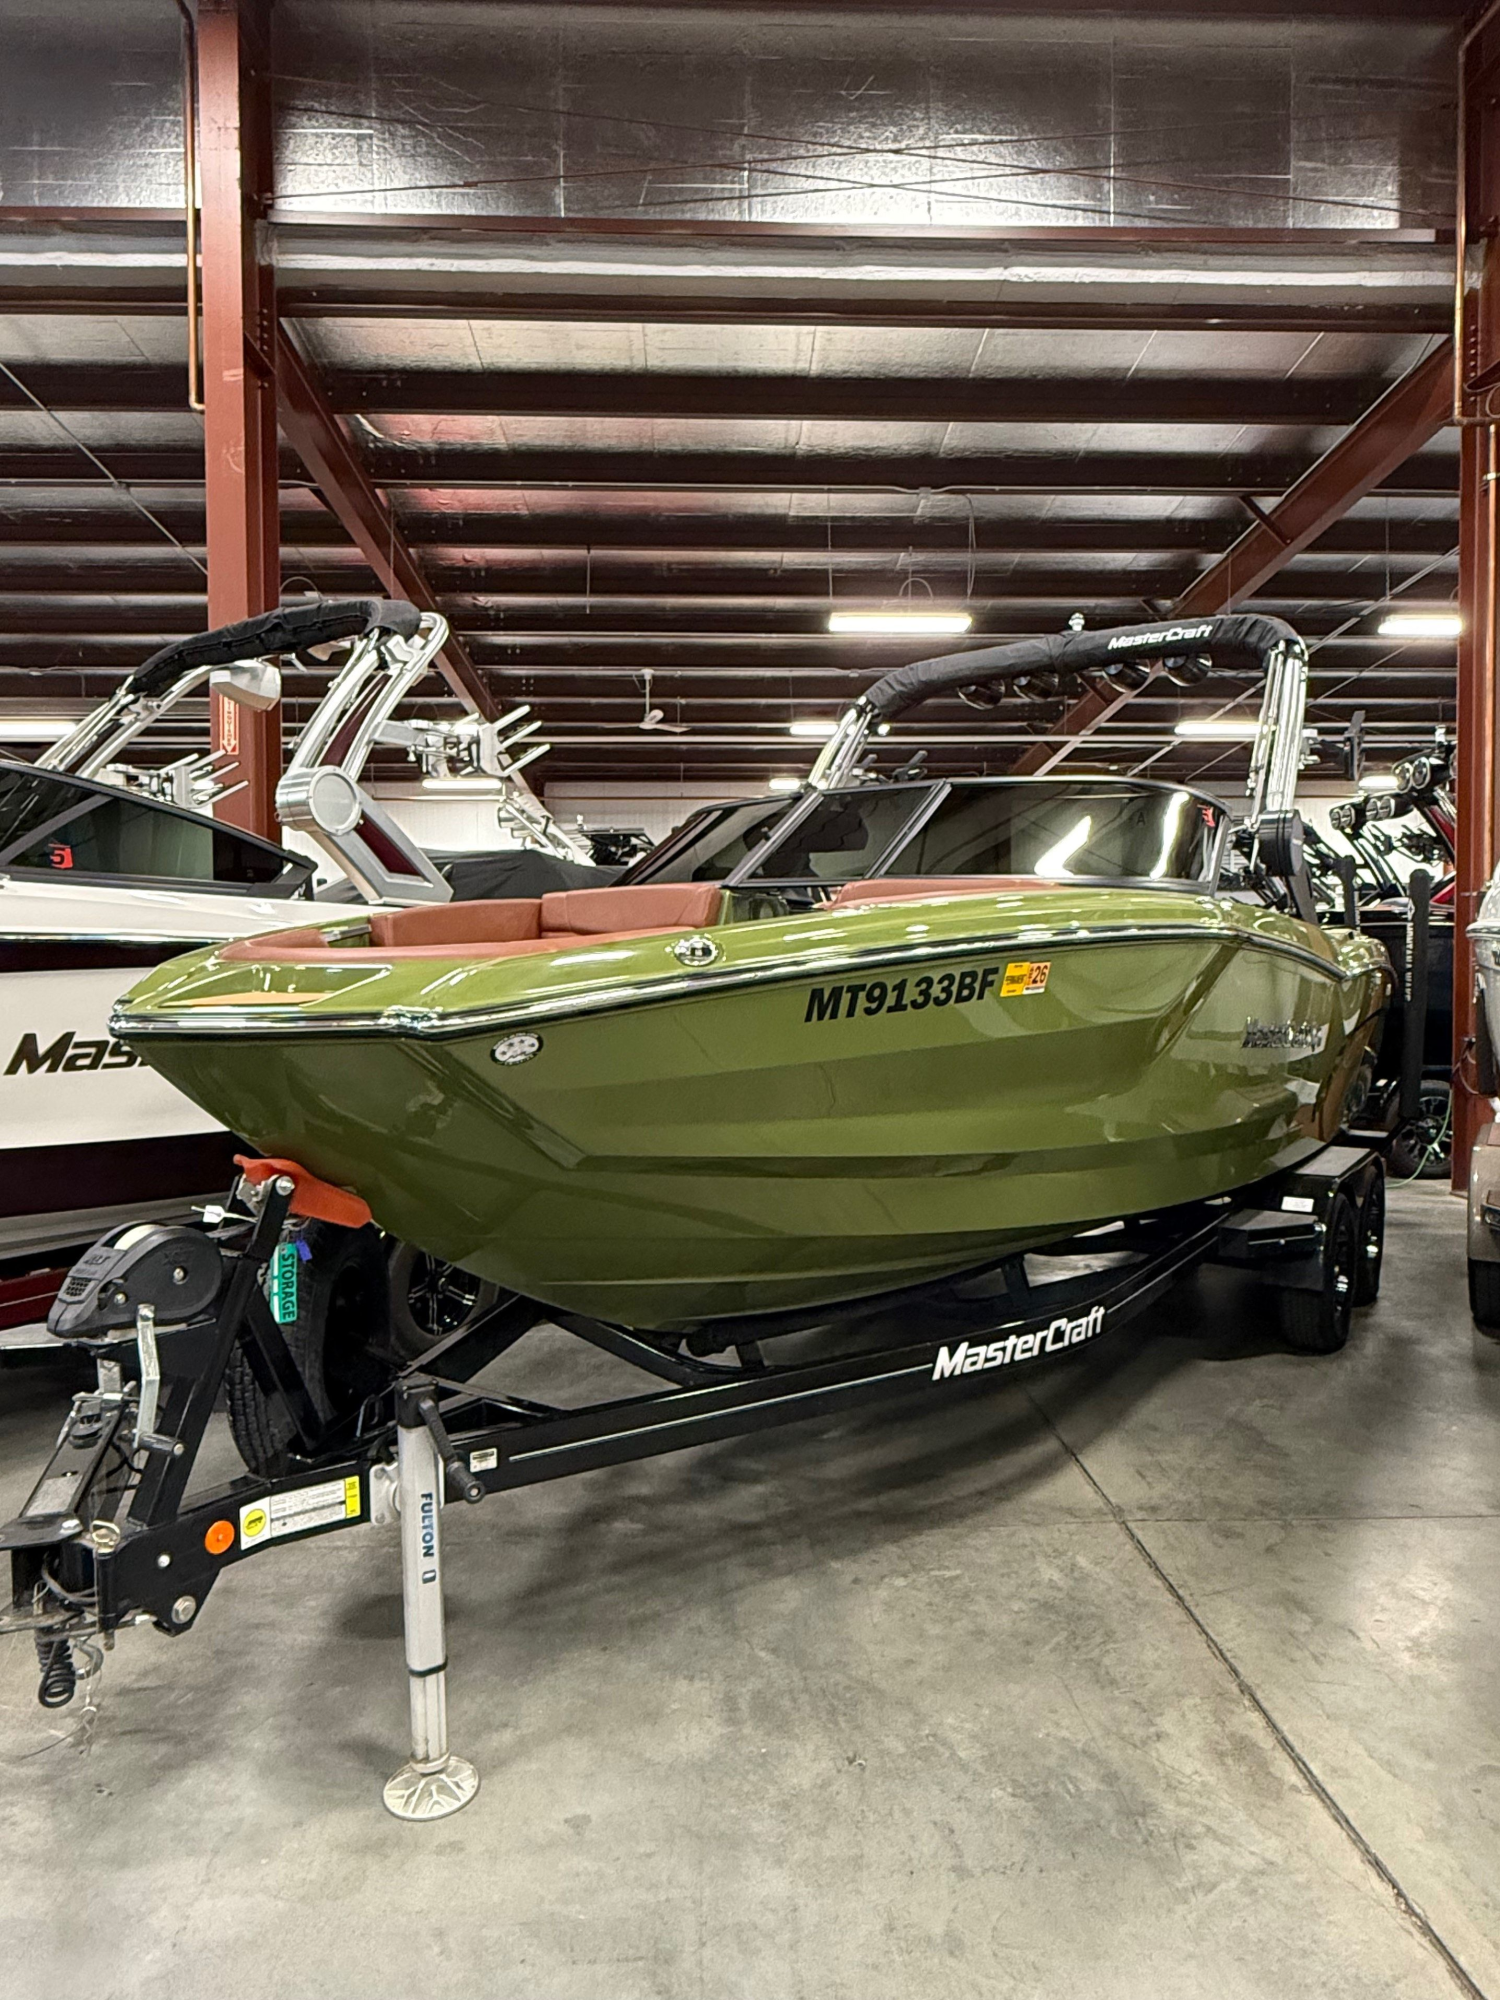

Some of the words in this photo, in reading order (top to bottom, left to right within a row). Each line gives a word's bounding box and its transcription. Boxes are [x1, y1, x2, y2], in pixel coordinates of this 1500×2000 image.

[1107, 624, 1213, 650] MasterCraft
[804, 966, 999, 1023] MT9133BF
[1032, 965, 1048, 985] 26
[281, 1253, 296, 1321] STORAGE
[932, 1305, 1105, 1381] MasterCraft
[420, 1492, 434, 1558] FULTON
